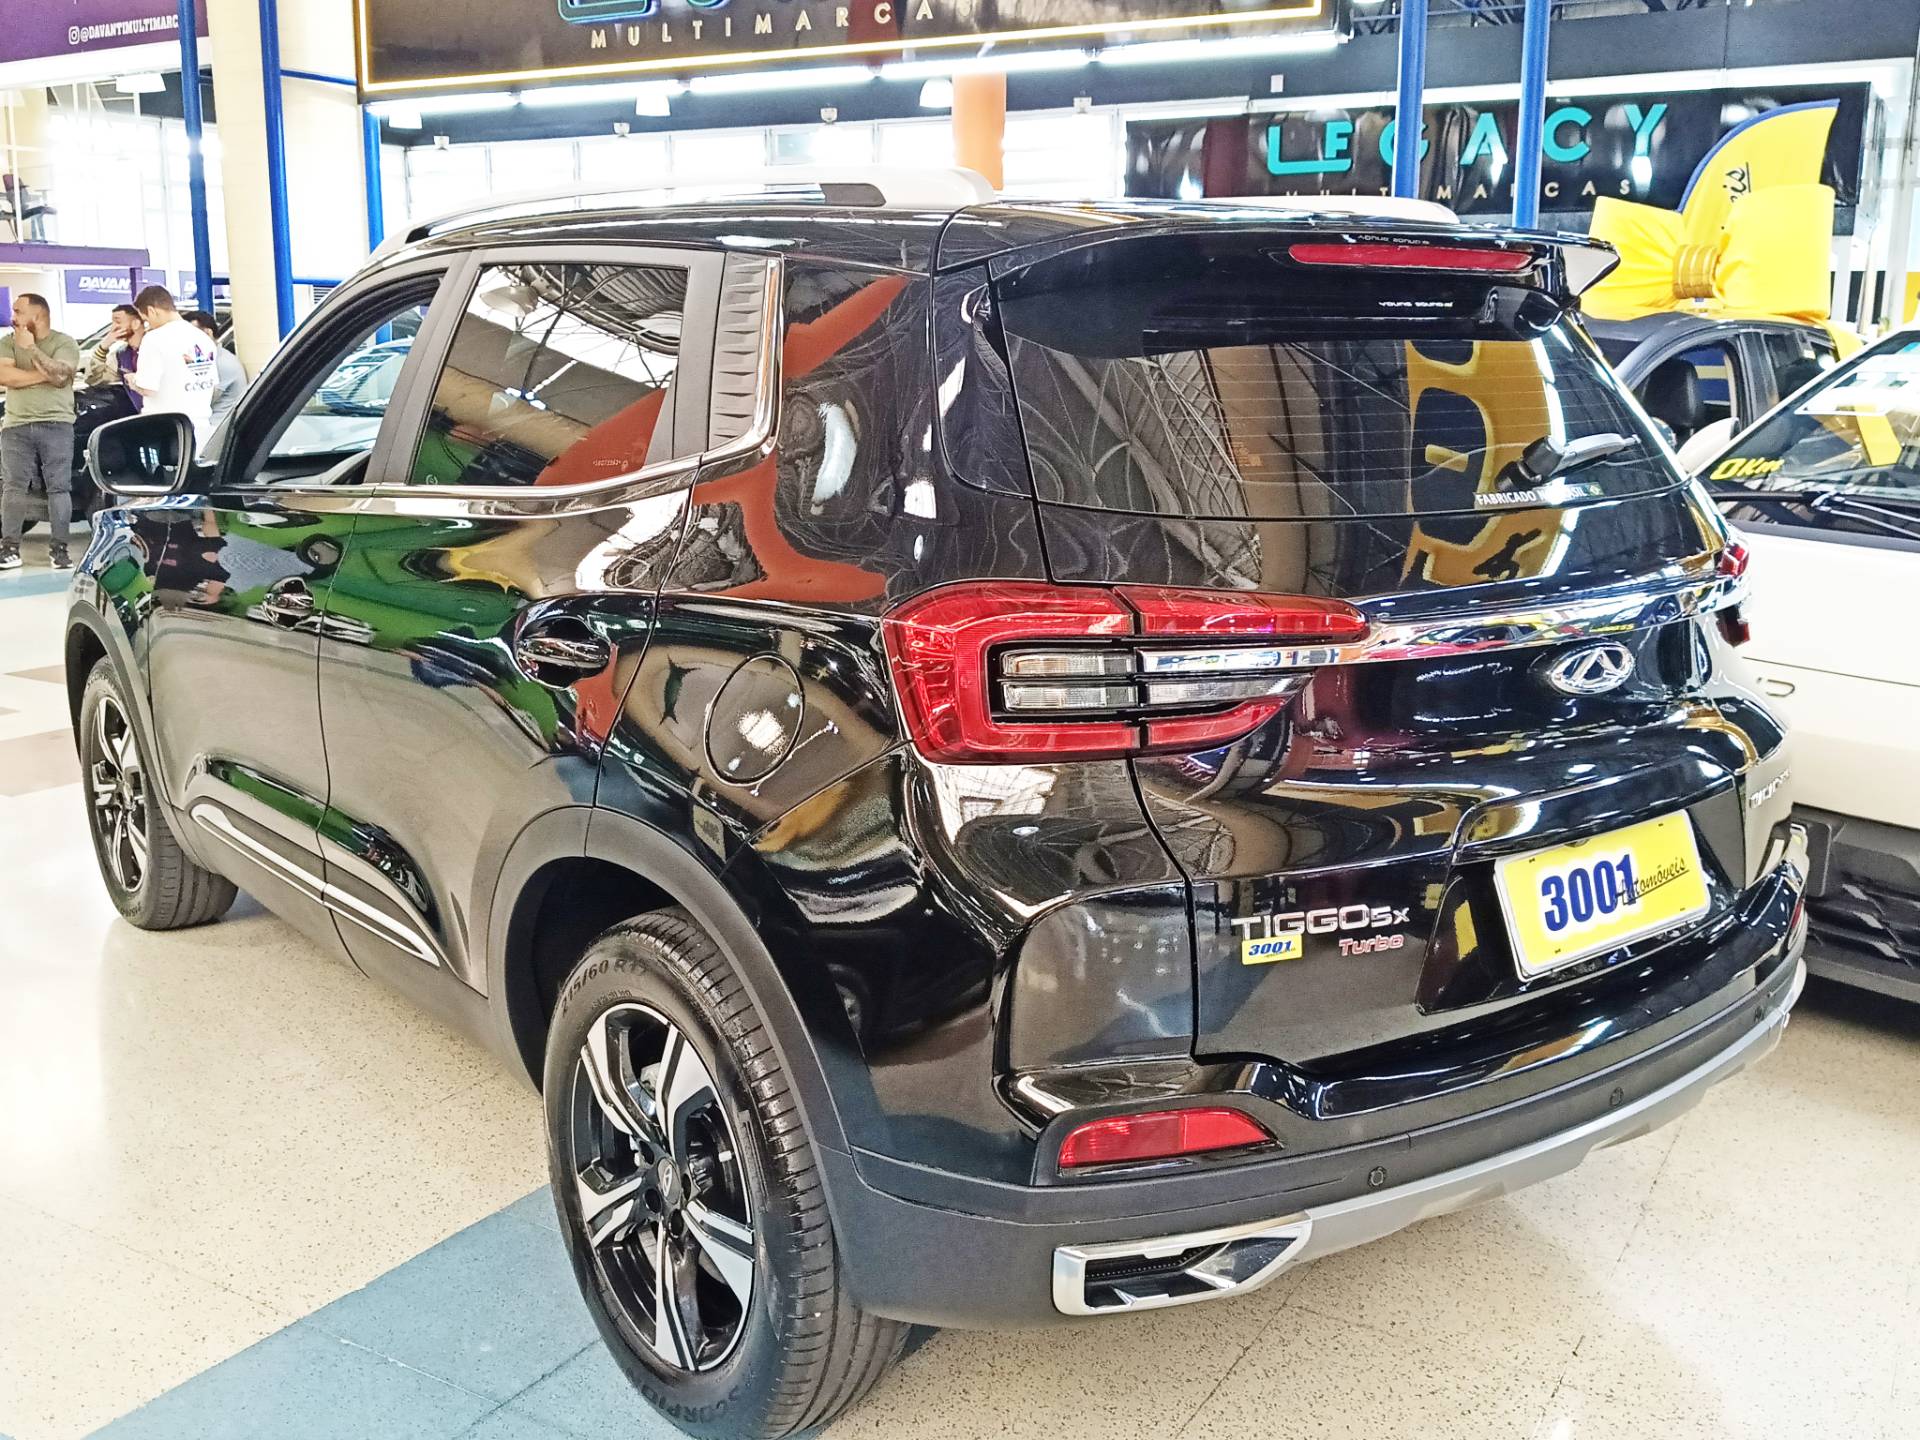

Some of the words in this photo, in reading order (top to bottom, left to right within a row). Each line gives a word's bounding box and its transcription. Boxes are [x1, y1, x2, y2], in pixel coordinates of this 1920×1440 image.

[80, 15, 178, 42] @DAVANTIMULTIMARC
[79, 276, 131, 290] DAVAN
[1476, 490, 1537, 506] FABRICADO
[1541, 853, 1637, 932] 3001
[1248, 940, 1293, 956] 3001
[1338, 933, 1405, 957] Turbo
